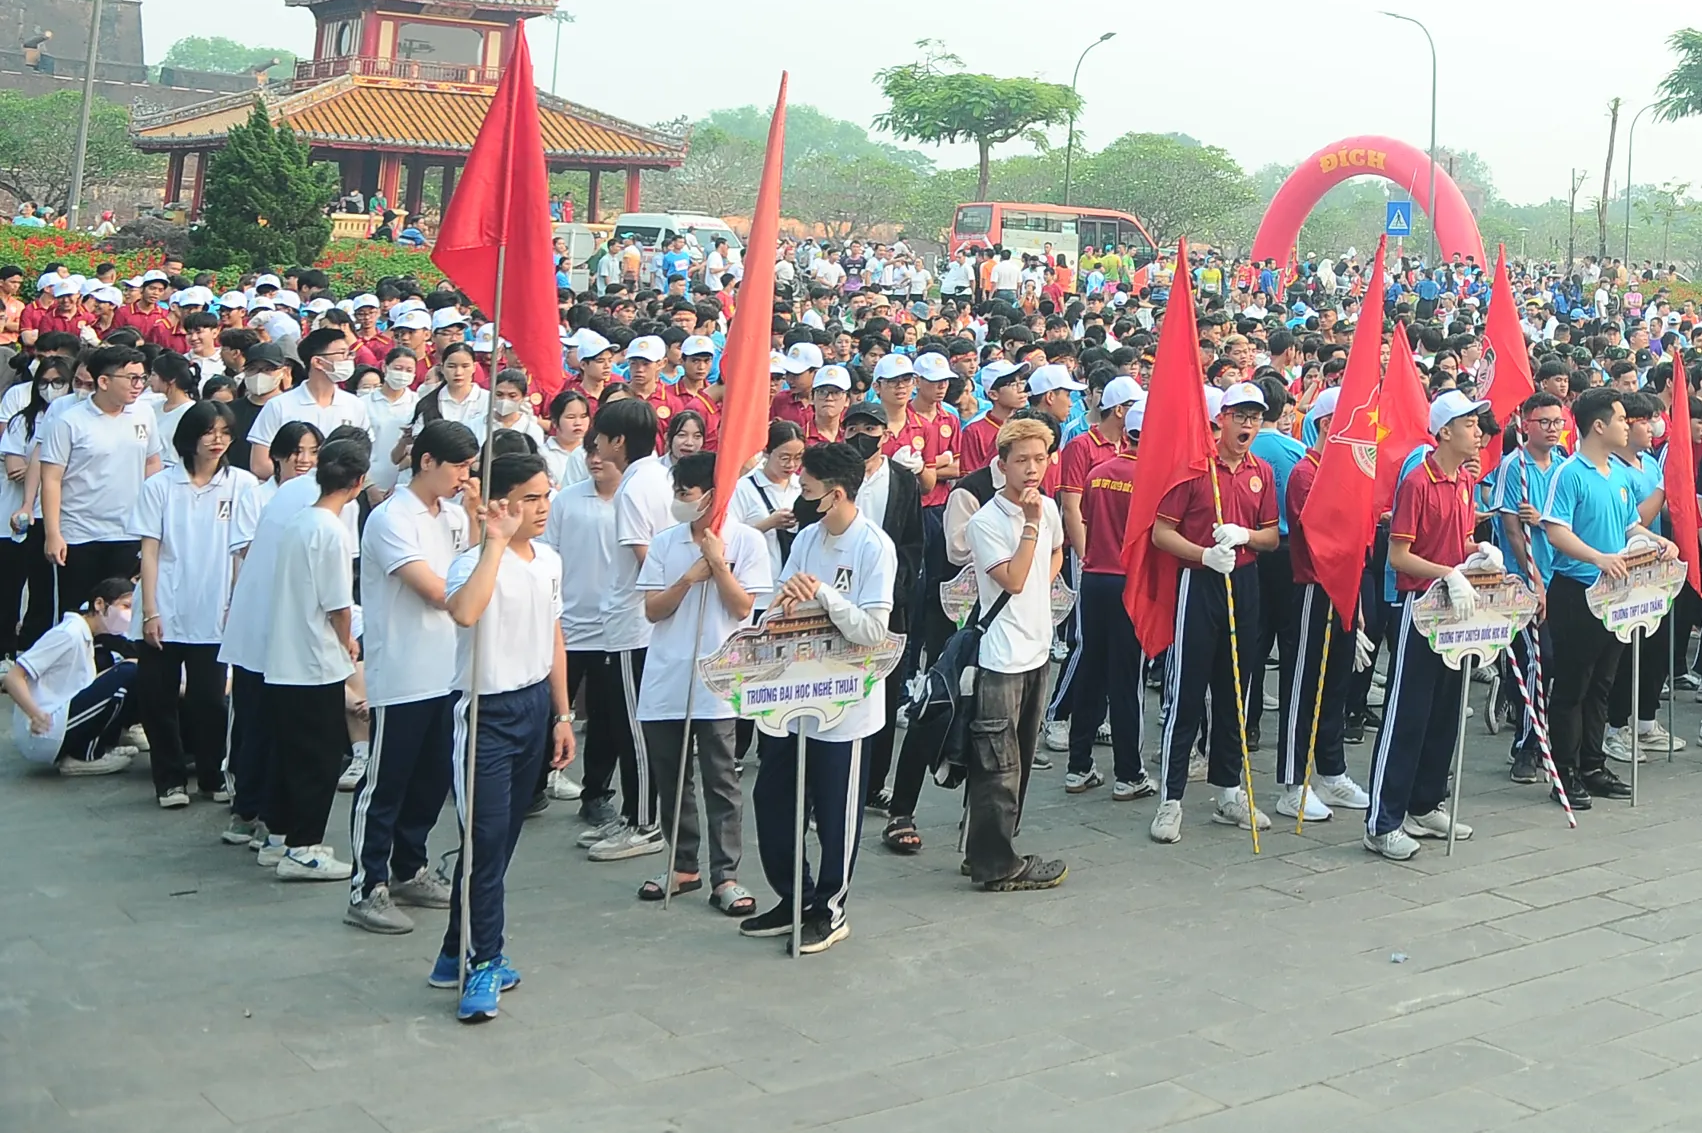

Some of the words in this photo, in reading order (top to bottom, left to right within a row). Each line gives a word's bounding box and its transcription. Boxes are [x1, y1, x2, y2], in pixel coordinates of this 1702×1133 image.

[1320, 146, 1386, 173] ĐÍCH
[1630, 605, 1639, 617] THPT
[1640, 602, 1649, 614] CAO
[1455, 630, 1465, 643] THPT
[747, 684, 777, 705] TRƯỜNG
[780, 687, 792, 704] ĐẠI
[795, 683, 811, 702] HỌC
[812, 678, 833, 699] NGHỆ
[835, 675, 859, 697] THUẬT
